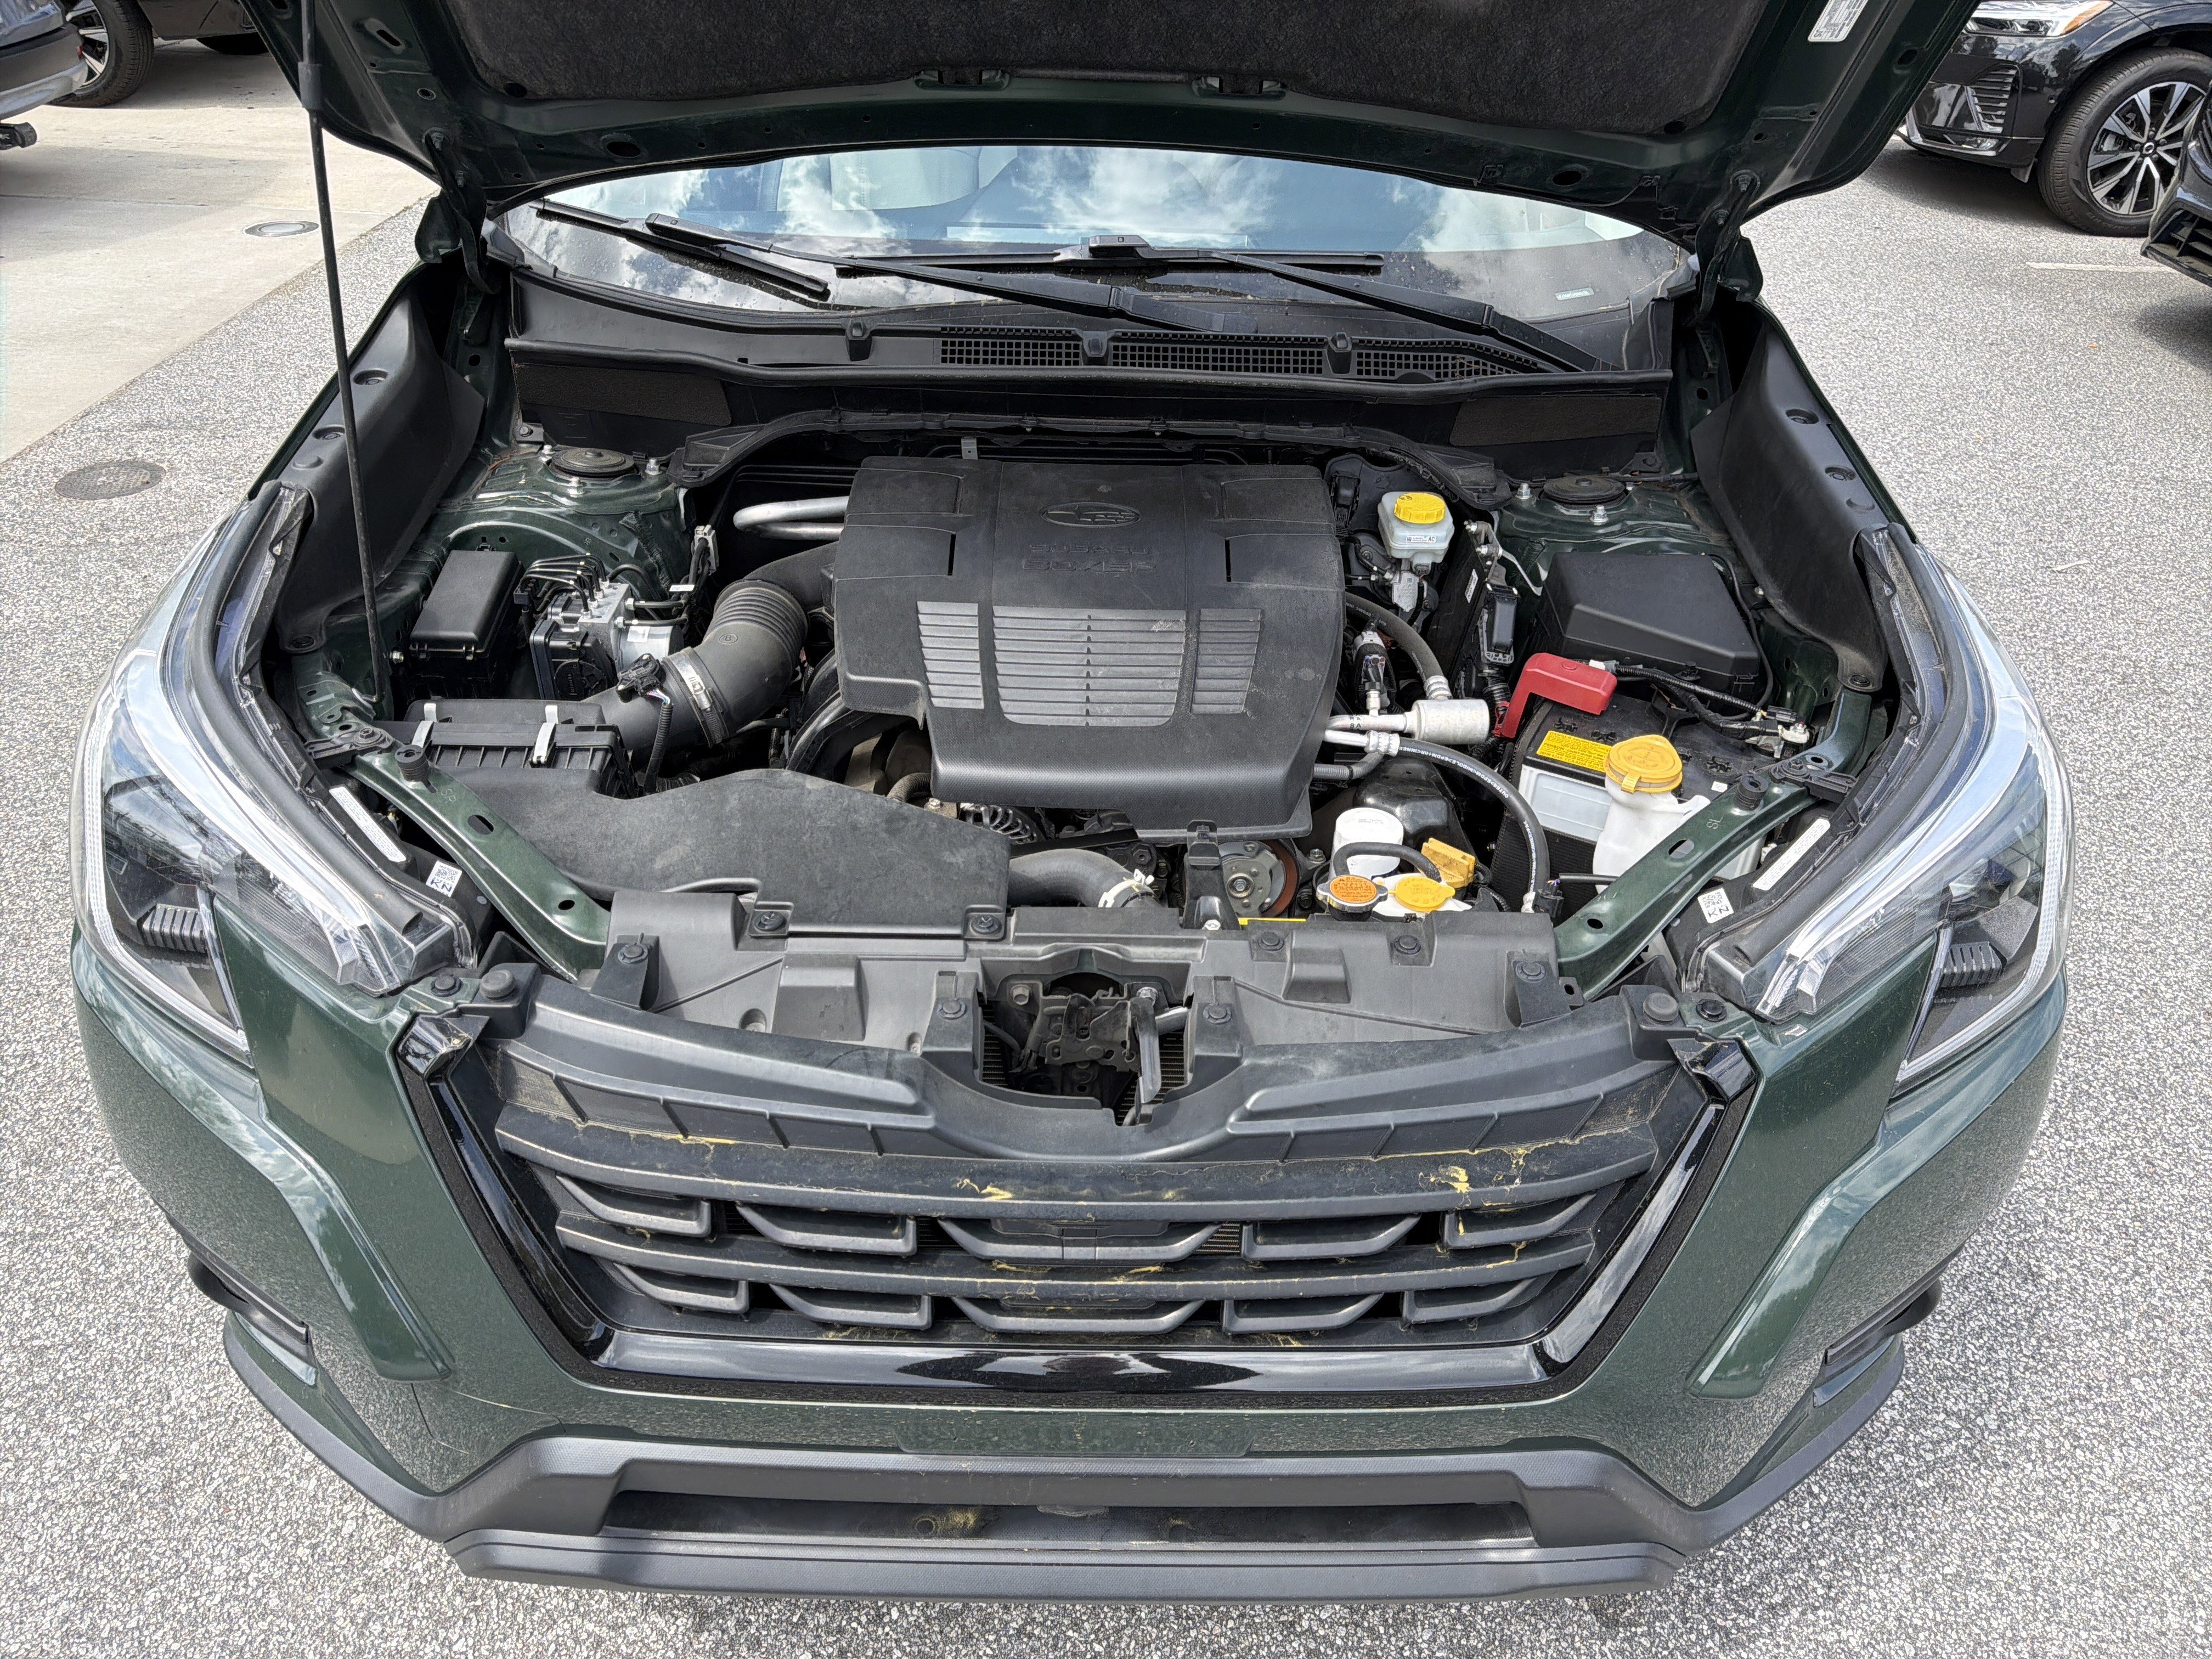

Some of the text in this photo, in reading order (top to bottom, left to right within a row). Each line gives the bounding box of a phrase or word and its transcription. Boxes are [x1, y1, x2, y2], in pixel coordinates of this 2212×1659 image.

[440, 788, 456, 803] SR
[1706, 816, 1723, 830] SL
[430, 879, 453, 893] KN
[1708, 906, 1729, 918] KN
